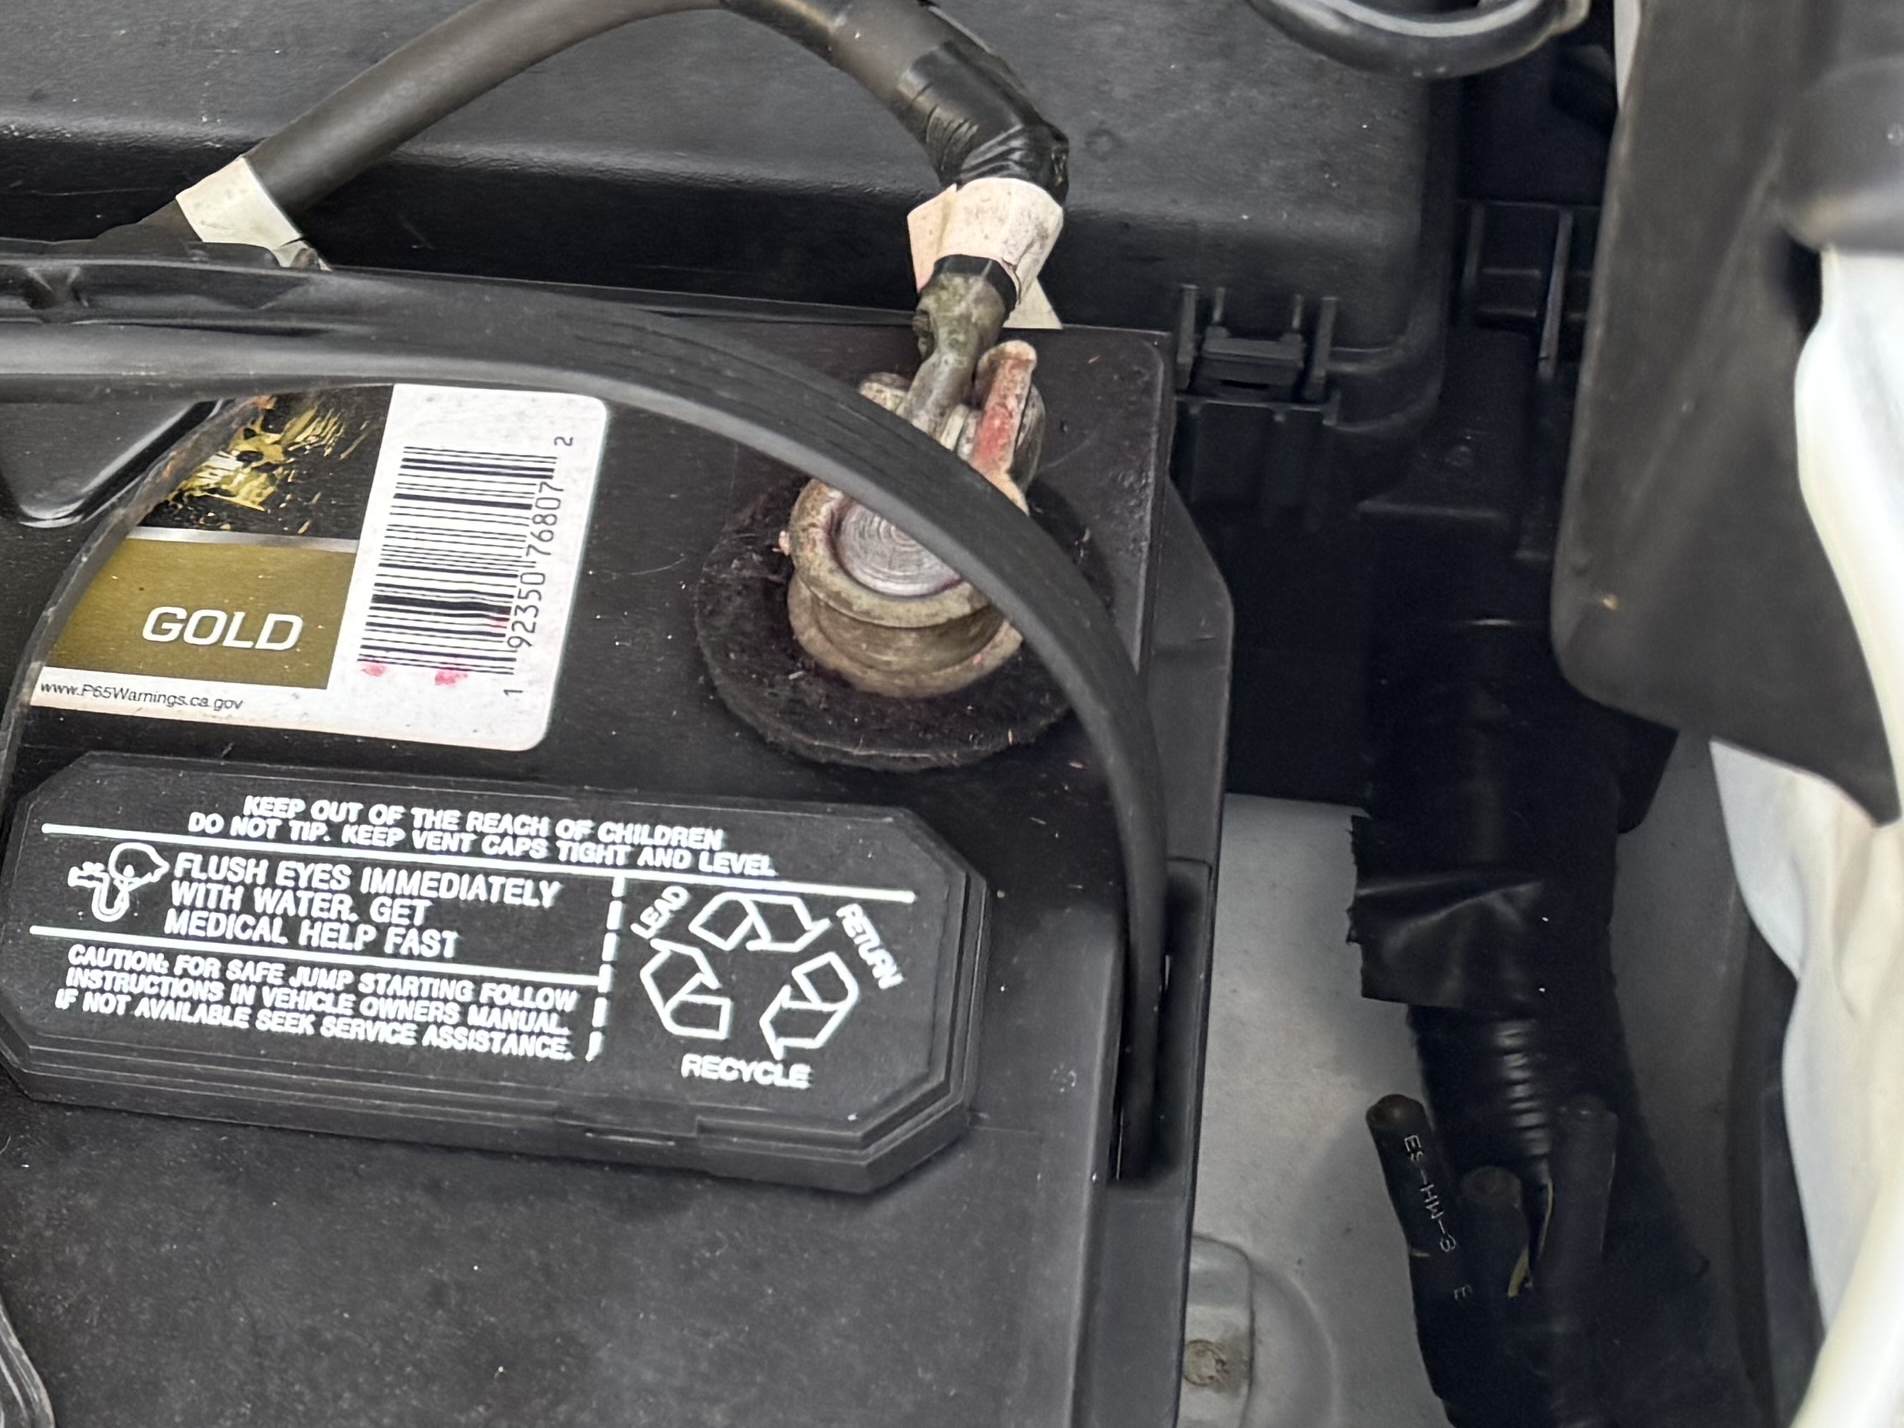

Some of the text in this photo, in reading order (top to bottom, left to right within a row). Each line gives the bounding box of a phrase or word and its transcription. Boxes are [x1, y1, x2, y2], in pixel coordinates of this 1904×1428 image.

[503, 435, 574, 700] 1 92350 76807 2
[141, 605, 304, 652] GOLD
[187, 811, 224, 834] DO
[228, 815, 283, 839] NOT
[287, 819, 331, 842] TIP.
[340, 823, 406, 847] KEEP
[411, 828, 478, 853] VENT
[480, 834, 549, 859] CAPS
[554, 839, 634, 866] TIGHT
[636, 845, 692, 869] AND
[242, 794, 724, 851] KEEP OUT OF THE REACH OF CHILDREN
[170, 880, 244, 911] WITH
[368, 895, 433, 925] GET
[173, 852, 562, 907] FLUSH EYES IMMEDIATELY
[163, 908, 459, 957] MEDICAL HELP FAST
[630, 884, 691, 940] LEAD
[835, 902, 905, 990] RETURN
[65, 966, 225, 1002] INSTRUCTIONS
[228, 982, 257, 1005] IN
[261, 985, 356, 1015] VEHICLE
[358, 995, 461, 1025] OWNERS
[172, 953, 221, 979] FOR
[225, 958, 286, 985] SAFE
[288, 965, 354, 990] JUMP
[357, 971, 475, 1002] STARTING
[478, 981, 578, 1011] FOLLOW
[54, 987, 79, 1010] IF
[81, 990, 132, 1015] NOT
[133, 996, 252, 1028] AVAILABLE
[254, 1007, 316, 1035] SEEK
[319, 1014, 418, 1045] SERVICE
[680, 1053, 811, 1089] RECYCLE
